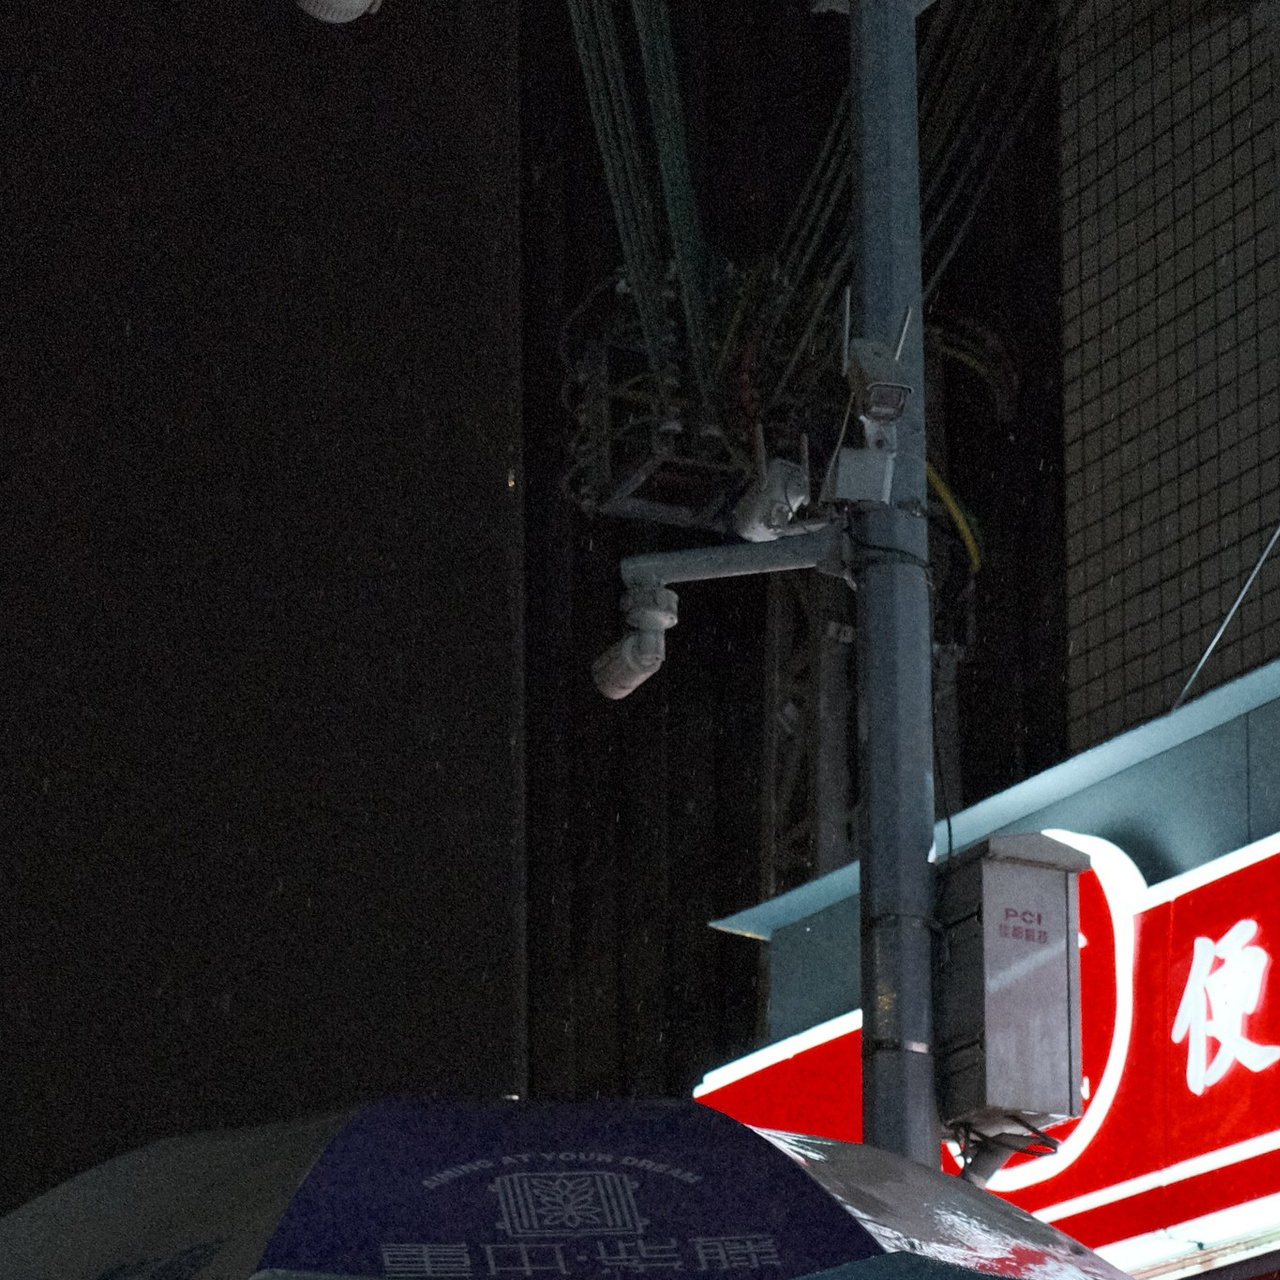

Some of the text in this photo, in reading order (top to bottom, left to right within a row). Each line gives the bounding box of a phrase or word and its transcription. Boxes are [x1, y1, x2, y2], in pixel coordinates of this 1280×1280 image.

[1004, 908, 1043, 926] PCI
[502, 1152, 532, 1167] AT
[541, 1150, 615, 1165] YOUR
[621, 1155, 704, 1186] DREAM
